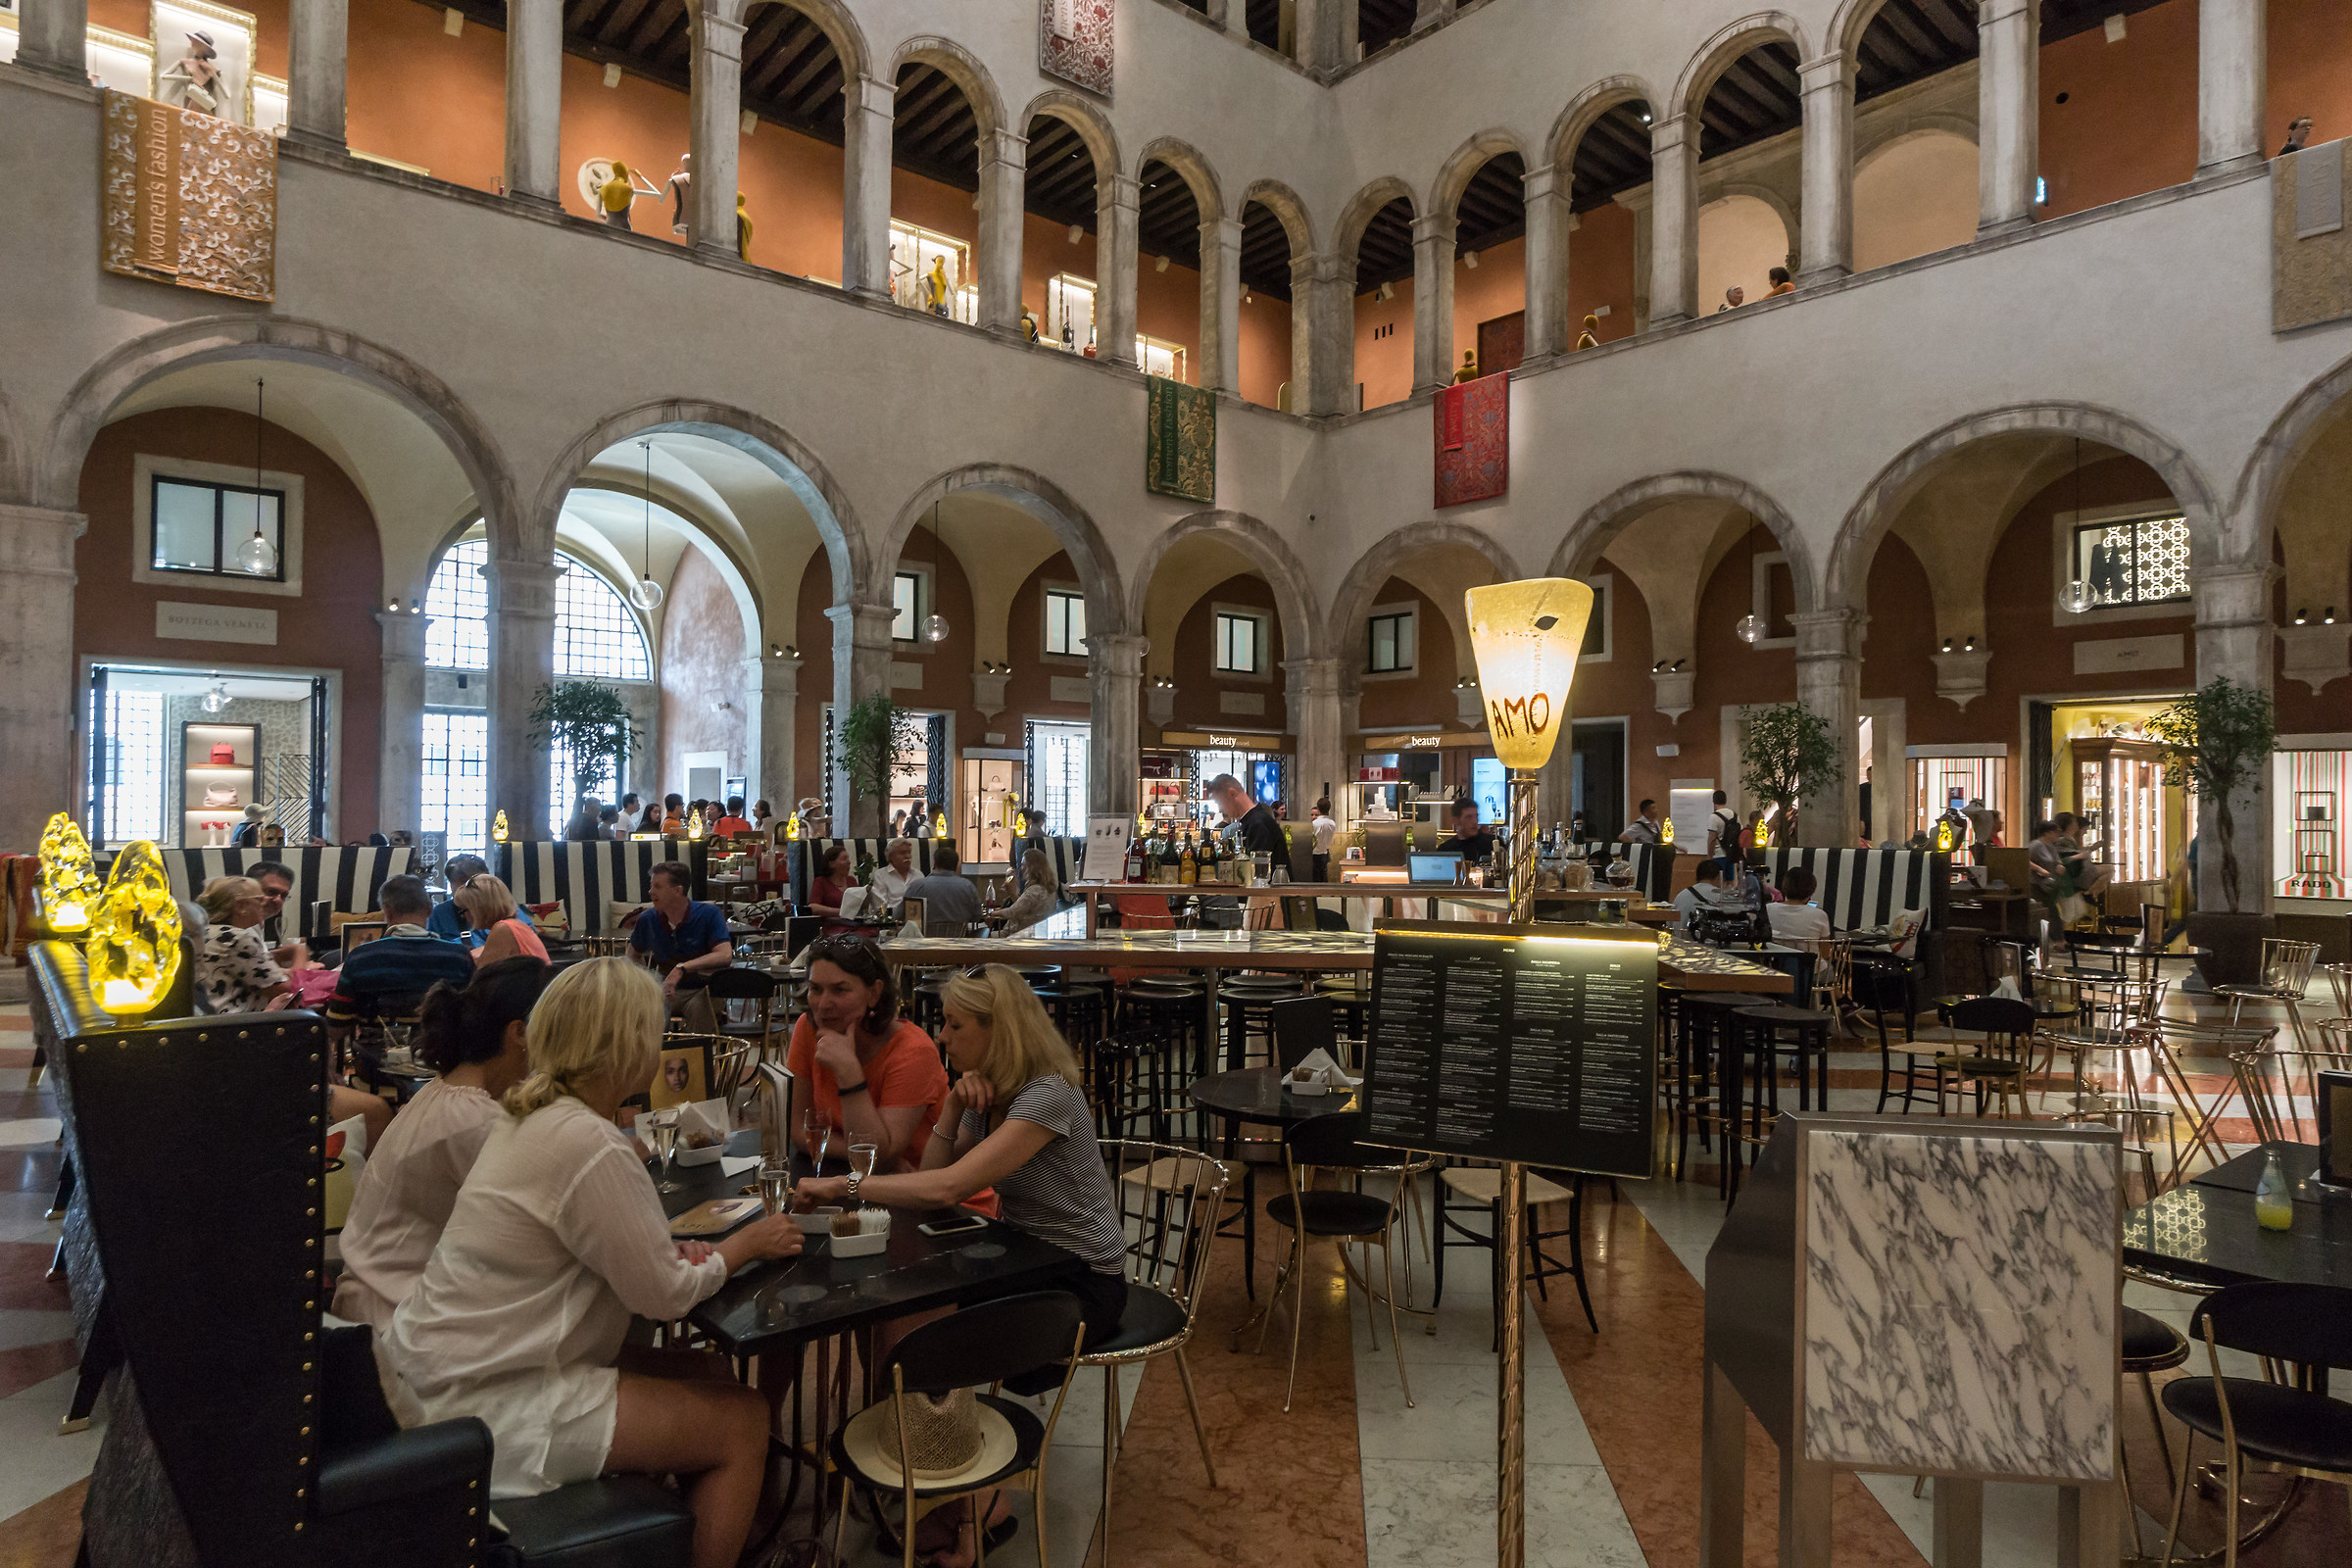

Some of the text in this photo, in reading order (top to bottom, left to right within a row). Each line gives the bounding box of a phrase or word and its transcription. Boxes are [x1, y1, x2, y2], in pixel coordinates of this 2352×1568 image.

[145, 109, 168, 262] women's fashion
[169, 615, 267, 629] BOTTEGA VENETA
[1492, 692, 1549, 740] AMO
[1209, 734, 1237, 748] beauty
[1411, 736, 1441, 748] beauty
[2291, 879, 2331, 888] RADO
